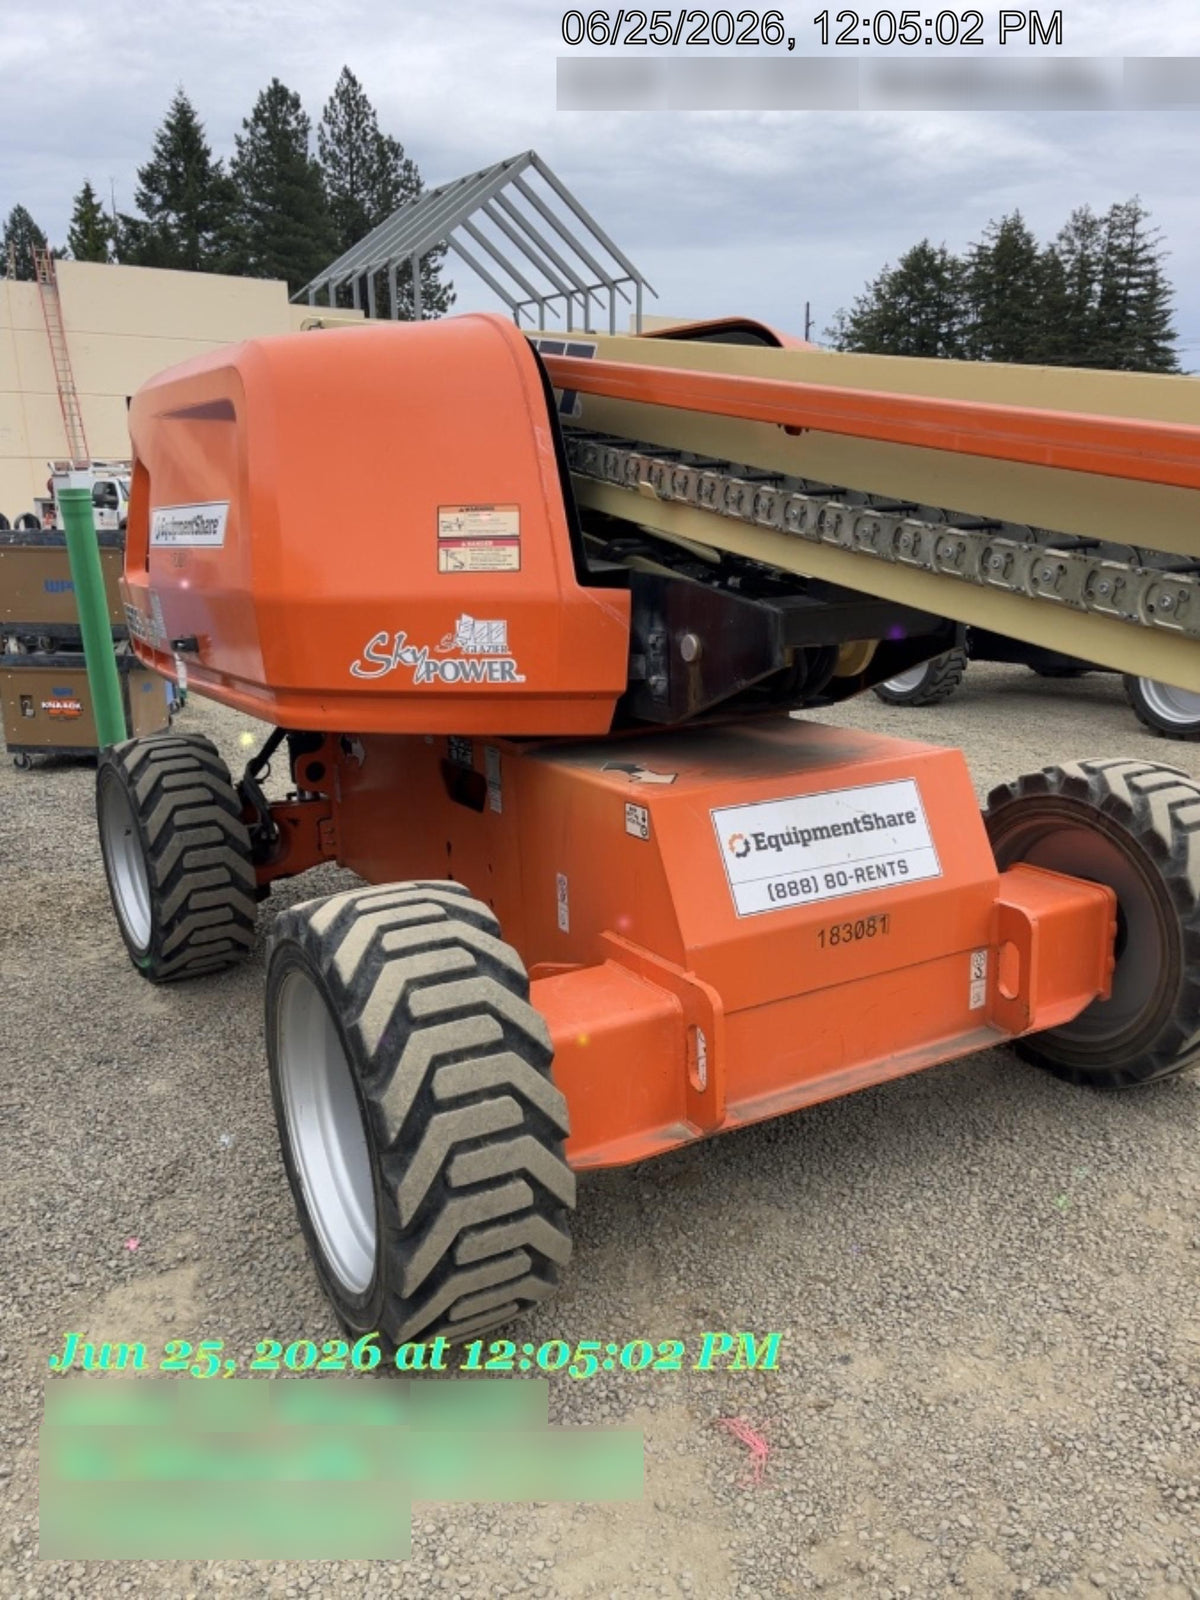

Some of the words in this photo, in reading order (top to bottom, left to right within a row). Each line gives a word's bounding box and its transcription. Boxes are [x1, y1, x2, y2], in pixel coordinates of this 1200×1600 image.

[350, 631, 430, 685] Sky
[423, 658, 516, 684] POWER
[750, 810, 917, 852] EquipmentShare
[767, 876, 819, 902] (888)
[824, 859, 909, 889] 80-RENTS
[817, 914, 890, 948] 183081
